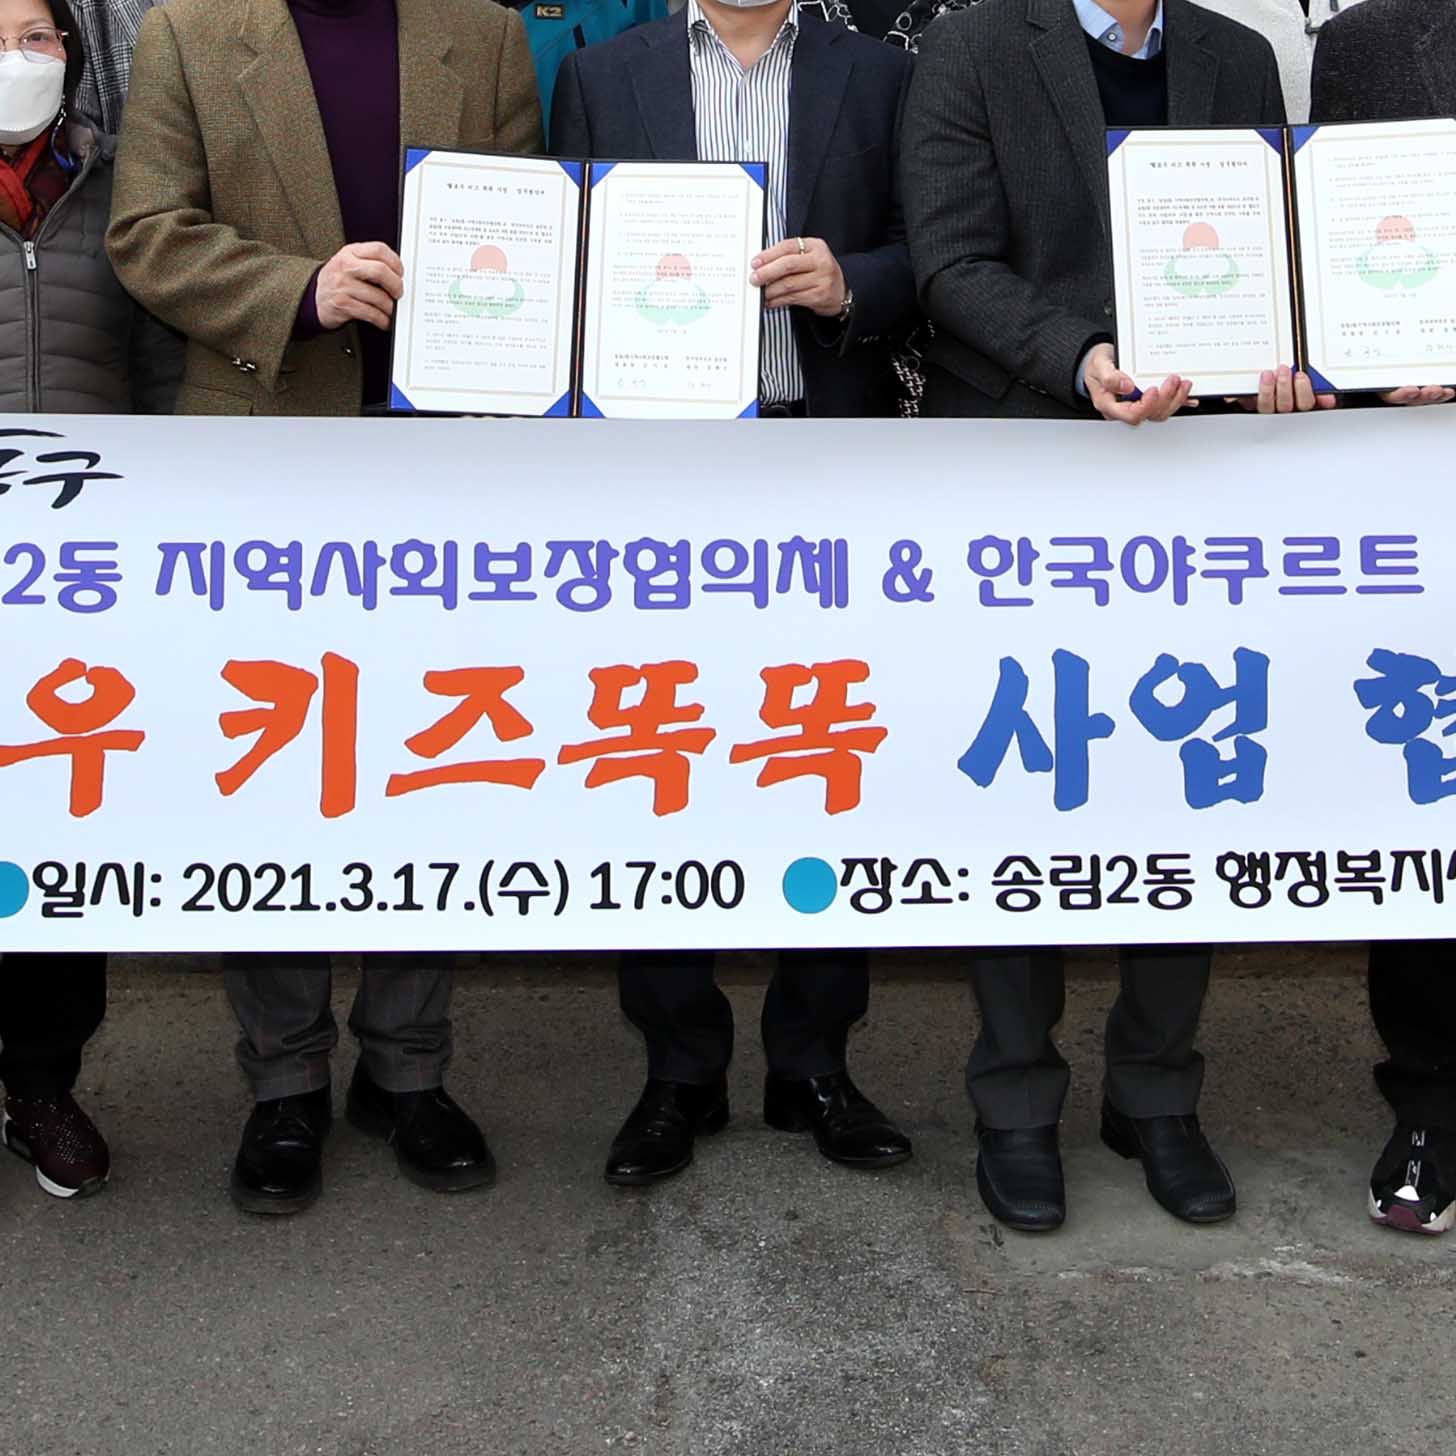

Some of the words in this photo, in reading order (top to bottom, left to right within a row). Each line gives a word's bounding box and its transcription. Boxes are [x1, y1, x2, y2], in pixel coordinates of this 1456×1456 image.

[536, 5, 563, 17] K2
[154, 535, 850, 612] 지역사회보장협의체
[882, 538, 935, 604] &
[966, 534, 1425, 607] 한국야쿠르트
[214, 651, 889, 819] 키즈똑똑
[956, 646, 1271, 812] 사업
[31, 860, 163, 918] 일시:
[181, 859, 570, 917] 2021.3.17.(수)
[589, 859, 746, 911] 17:00
[839, 856, 970, 914] 장소:
[990, 853, 1196, 912] 송림2동
